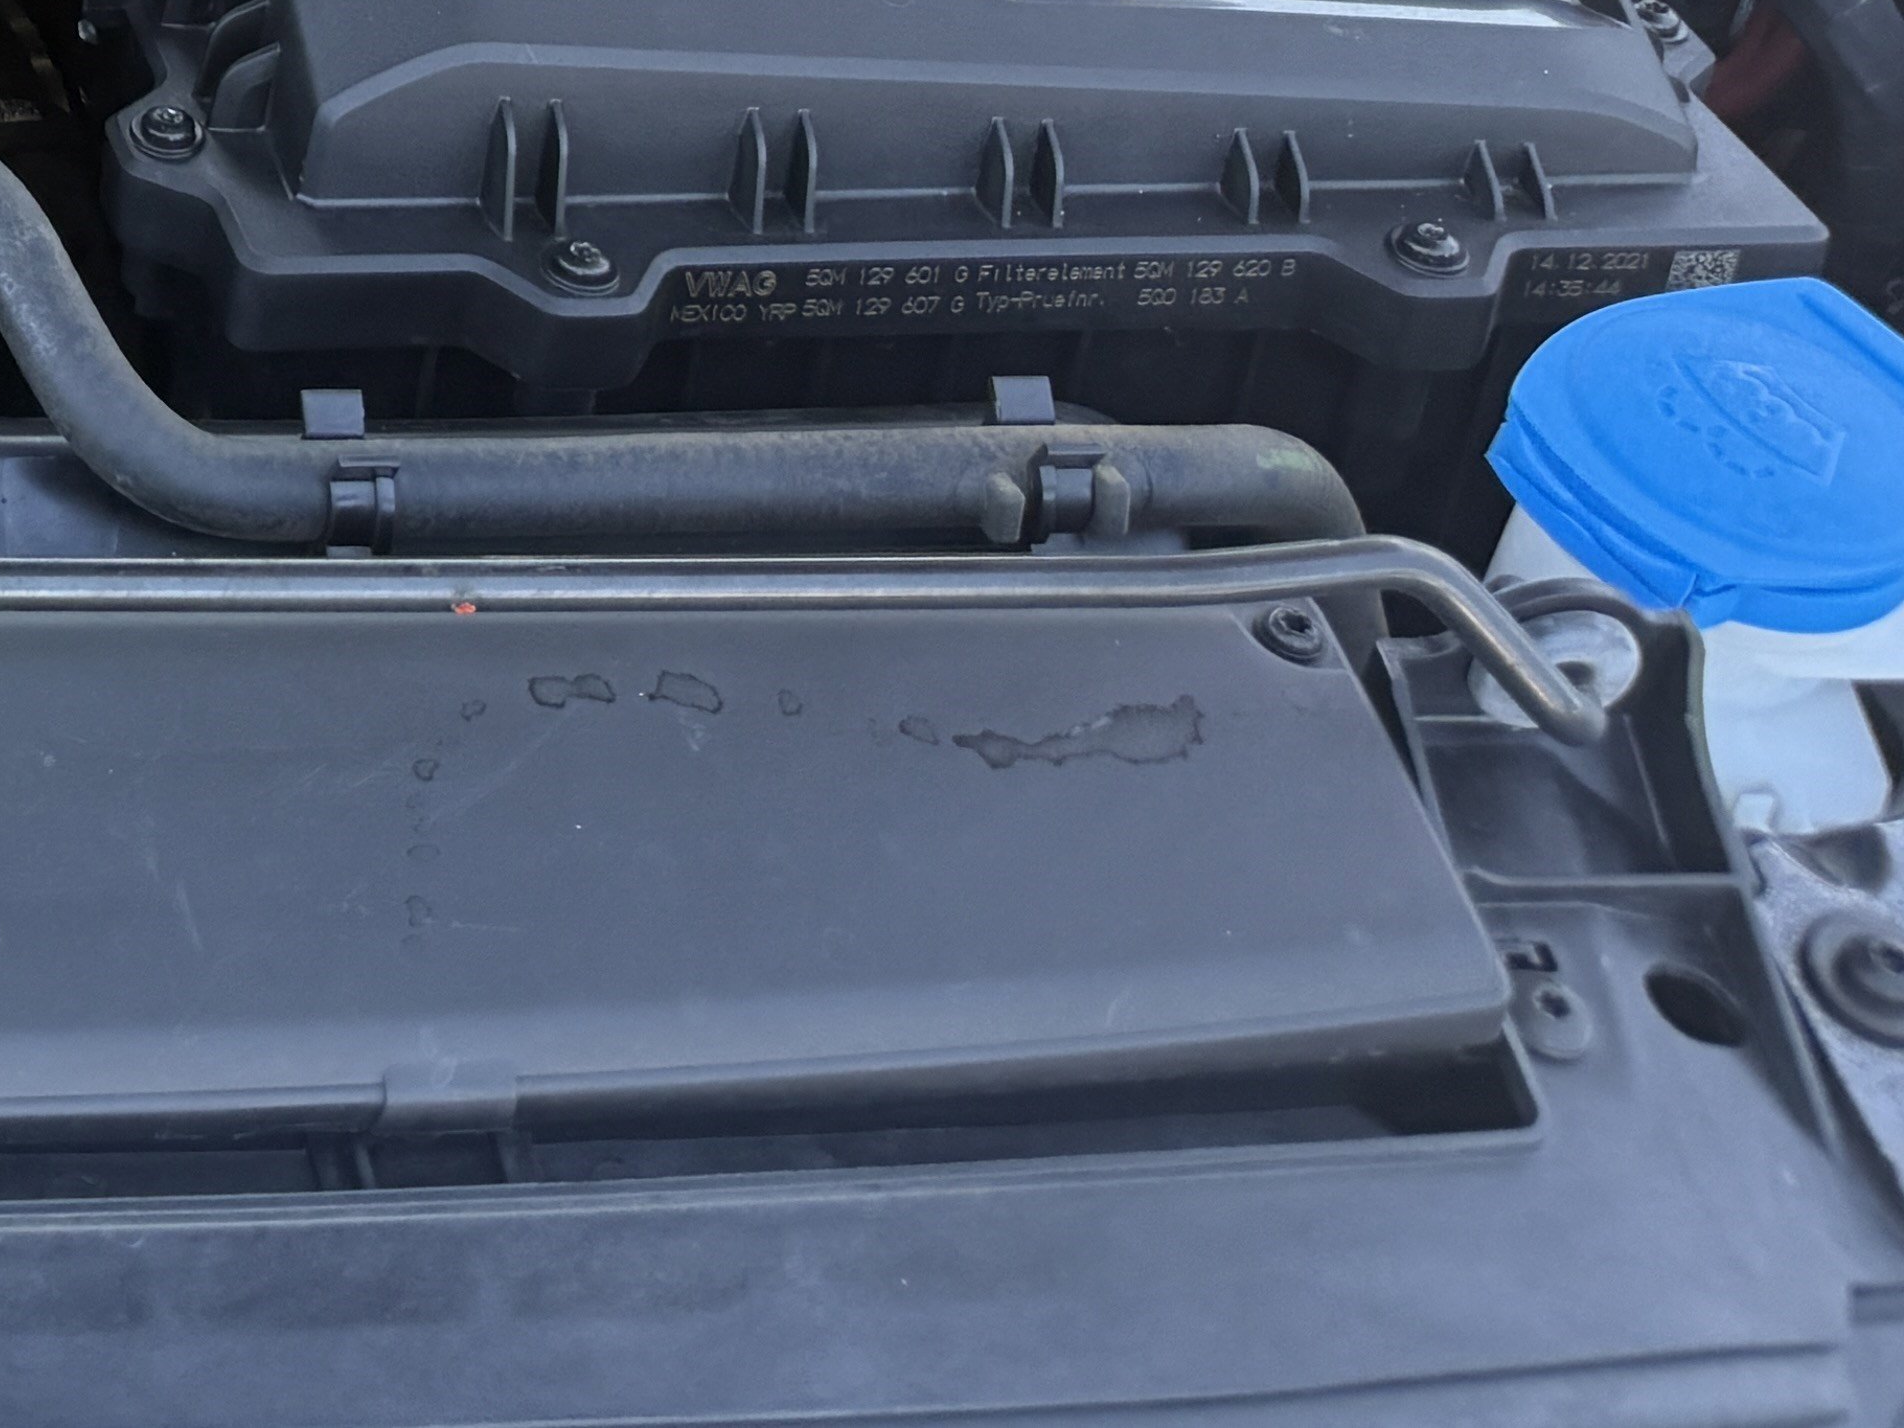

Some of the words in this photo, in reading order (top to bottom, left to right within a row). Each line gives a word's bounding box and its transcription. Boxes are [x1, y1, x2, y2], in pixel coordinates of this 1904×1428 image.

[685, 269, 777, 298] VWAG
[859, 266, 895, 286] 129
[904, 265, 941, 284] 601
[954, 265, 969, 283] G
[977, 261, 1125, 282] Filterelement
[1186, 260, 1223, 279] 129
[1232, 259, 1272, 277] 620
[1280, 259, 1297, 276] B
[670, 303, 748, 323] MEXICO
[855, 297, 892, 316] 129
[901, 296, 941, 314] 607
[950, 295, 966, 313] G
[1191, 287, 1227, 306] 183
